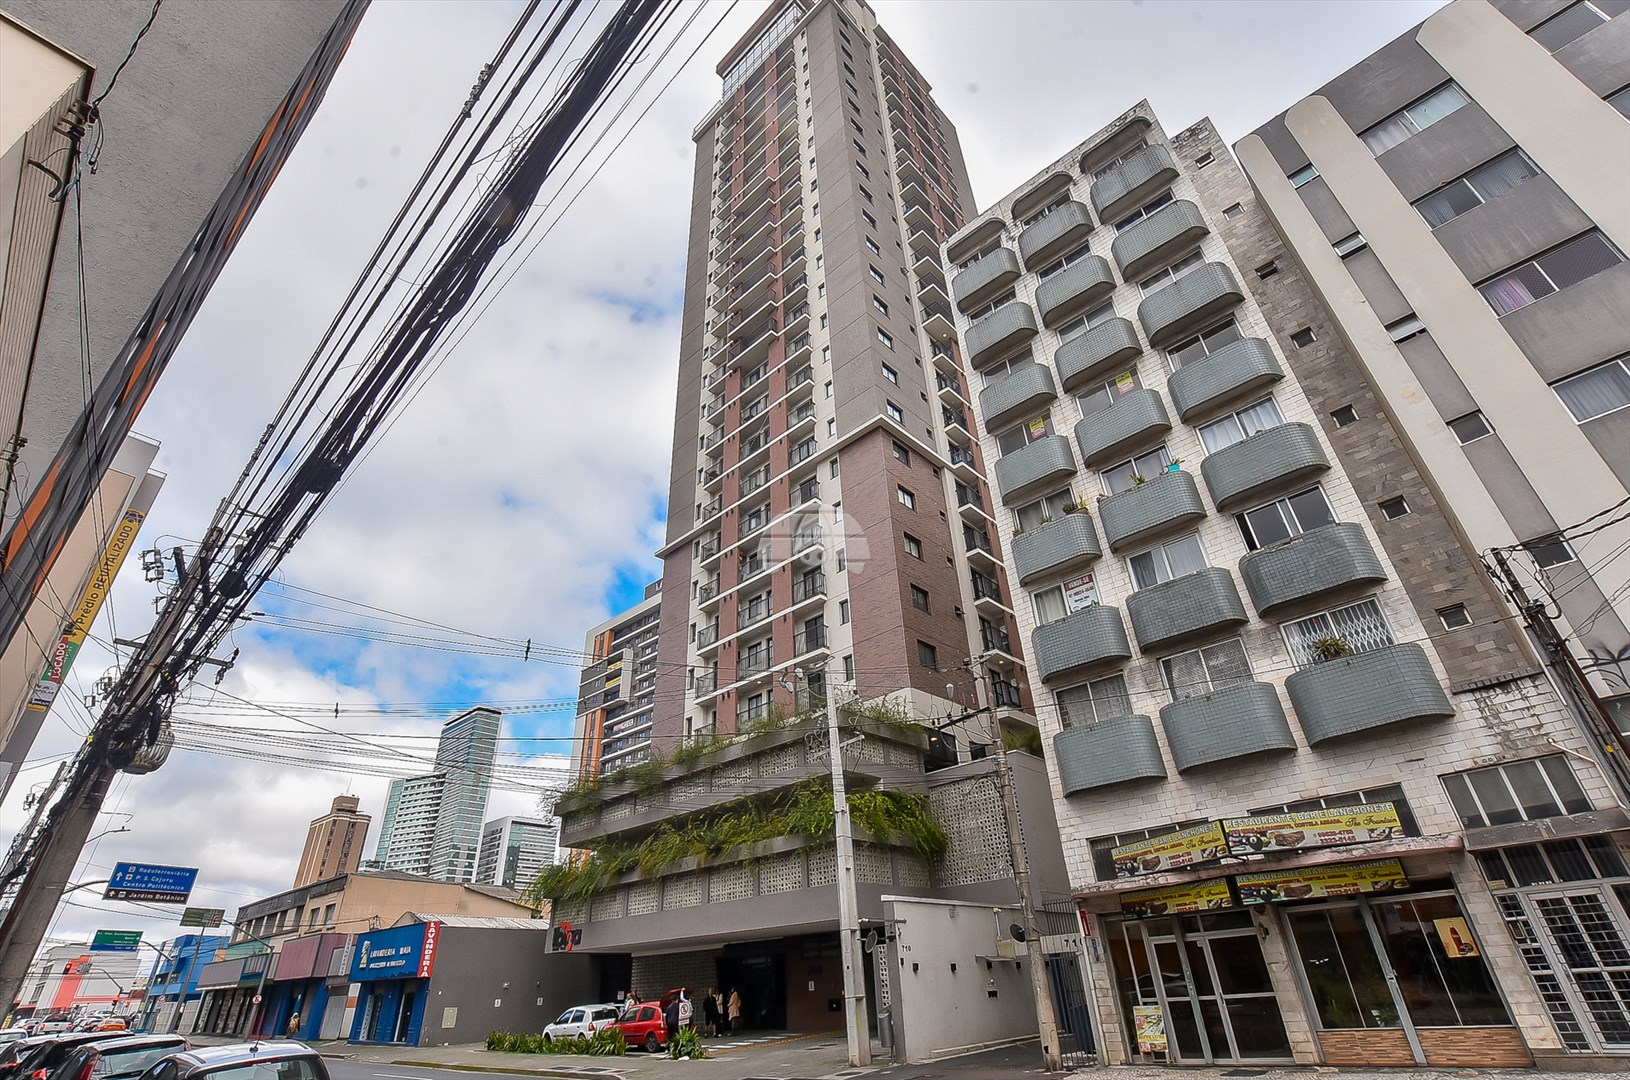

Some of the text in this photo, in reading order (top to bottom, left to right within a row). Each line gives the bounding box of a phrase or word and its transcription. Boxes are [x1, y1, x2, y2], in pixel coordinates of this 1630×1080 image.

[76, 525, 133, 624] Prédio REVITALIZADO
[51, 643, 66, 679] LOCADO
[1226, 803, 1393, 829] RESTAURANTE, BAR E LANCHONETE
[1345, 815, 1398, 828] The Fountain
[1155, 837, 1168, 846] BAR
[1175, 823, 1218, 840] LANCHONETE
[1186, 839, 1196, 849] The
[138, 867, 190, 877] Rodoferroviária
[147, 882, 185, 890] Politécnico
[155, 893, 185, 901] Botânico
[420, 922, 436, 977] LAVANDERIA
